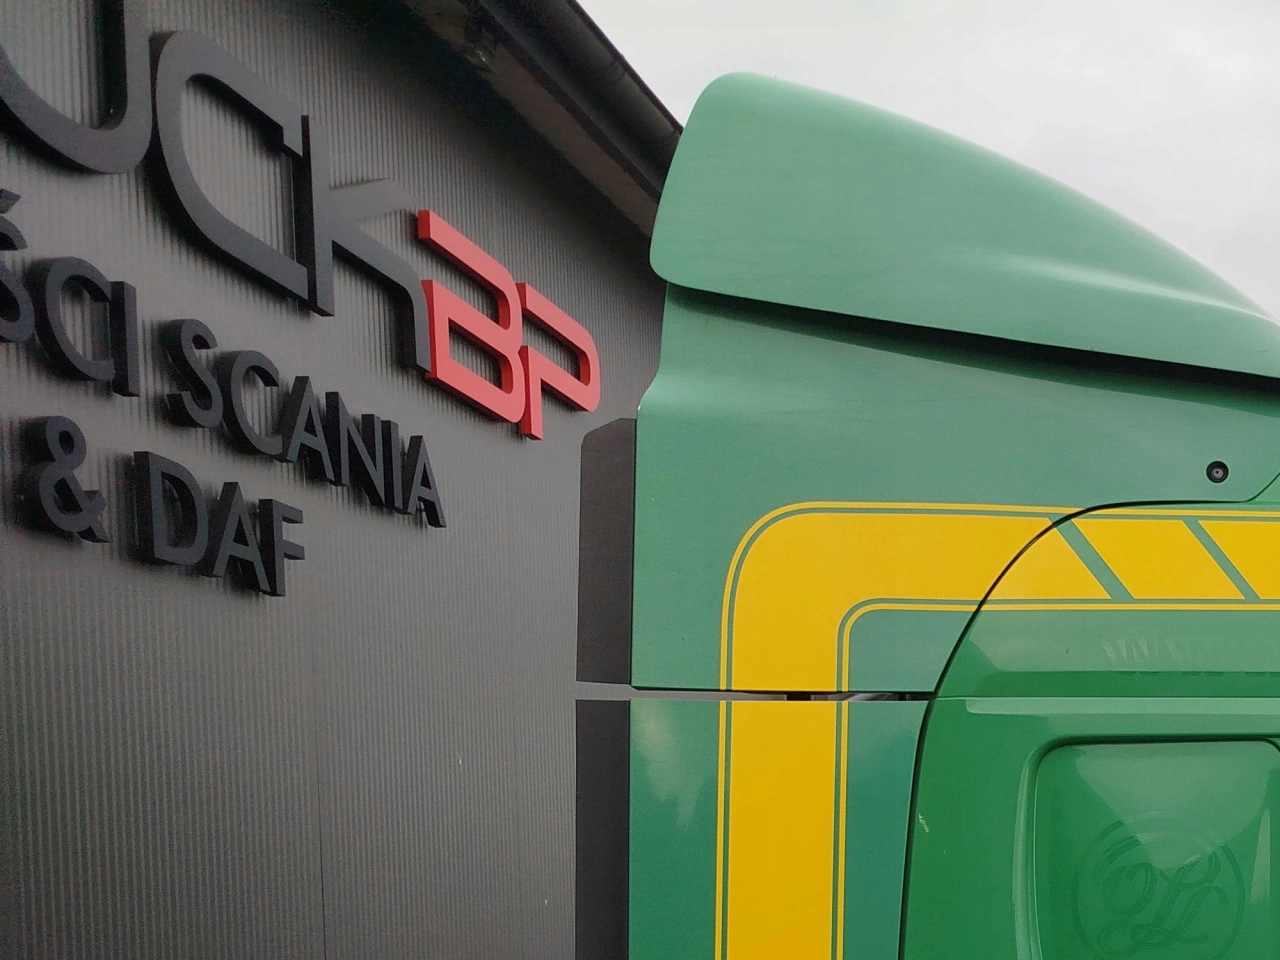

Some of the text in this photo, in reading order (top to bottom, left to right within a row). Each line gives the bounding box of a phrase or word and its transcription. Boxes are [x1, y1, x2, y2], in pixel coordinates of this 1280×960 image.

[38, 416, 305, 597] & DAF
[162, 318, 447, 528] SCANIA
